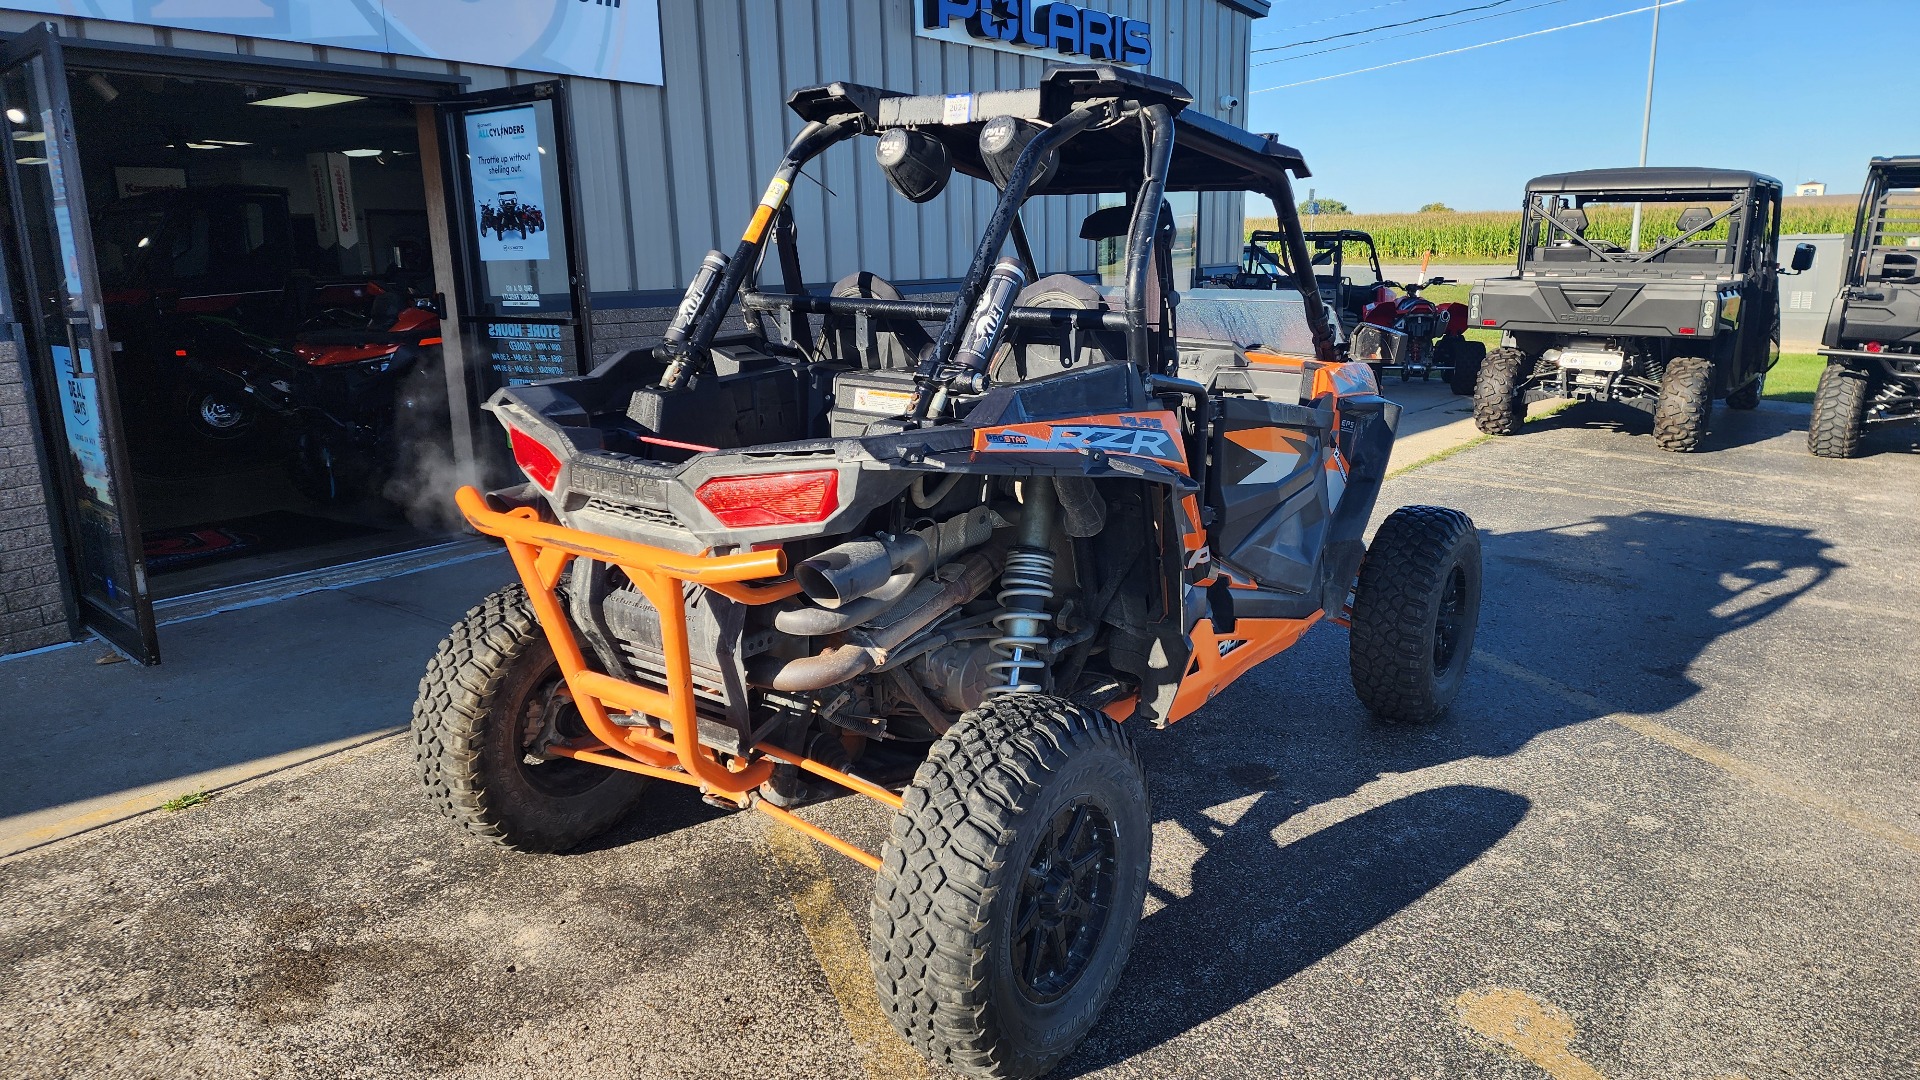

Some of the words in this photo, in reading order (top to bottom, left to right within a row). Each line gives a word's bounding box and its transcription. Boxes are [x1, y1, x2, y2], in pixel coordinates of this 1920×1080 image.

[927, 0, 1152, 66] POLARIS
[949, 103, 966, 112] 2024
[984, 127, 1007, 138] PYLE
[880, 141, 900, 151] PYLE
[478, 156, 500, 165] Throttle
[501, 156, 508, 165] up
[509, 152, 531, 162] without
[488, 165, 510, 175] shelling
[510, 164, 522, 173] out.
[333, 165, 349, 232] Kawasaki
[683, 287, 706, 326] FOX
[1560, 313, 1611, 323] CFMOTO
[980, 303, 1004, 349] FOX
[67, 380, 86, 400] DEAL
[72, 400, 87, 416] DAYS
[1118, 415, 1164, 430] POLARIS
[1341, 419, 1355, 429] EPS
[1045, 425, 1171, 457] RZR
